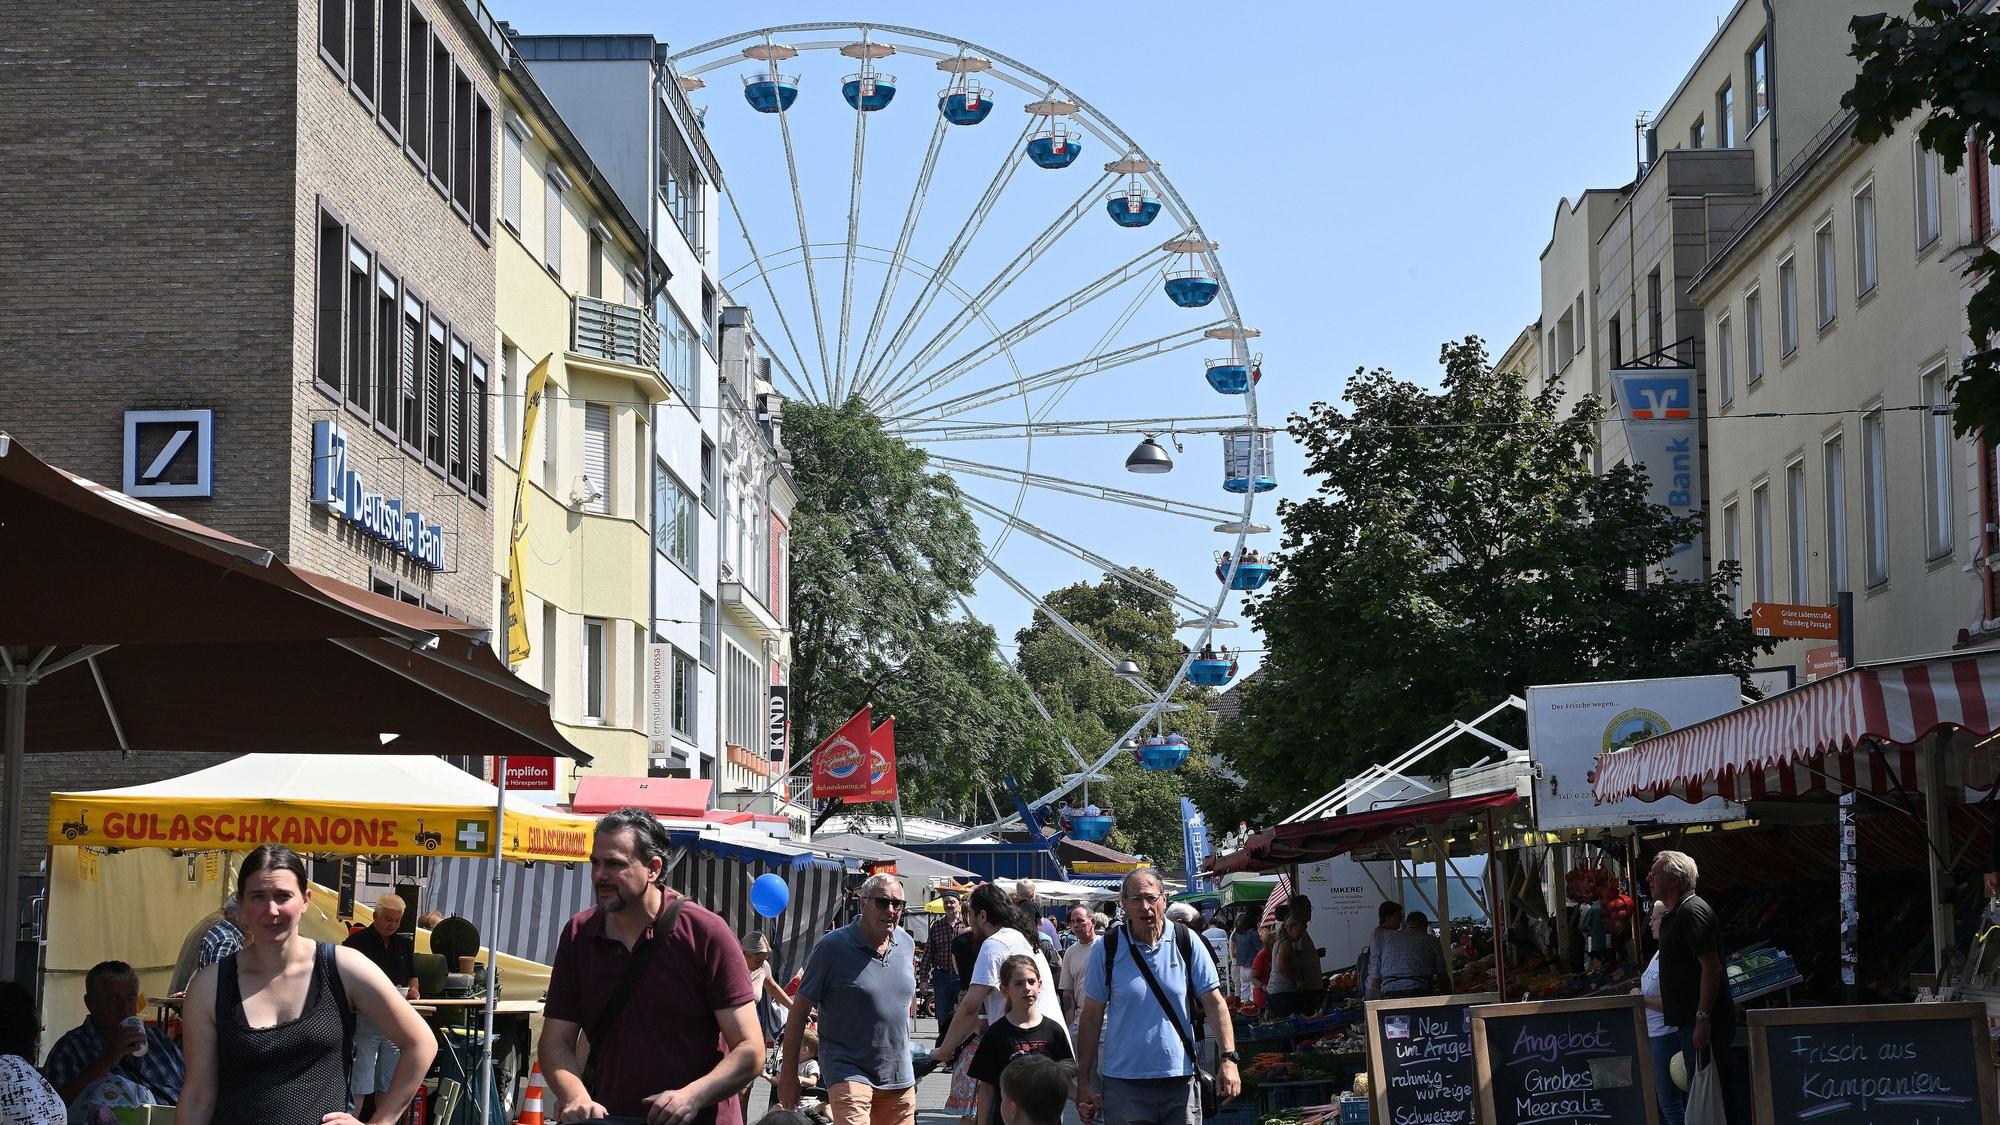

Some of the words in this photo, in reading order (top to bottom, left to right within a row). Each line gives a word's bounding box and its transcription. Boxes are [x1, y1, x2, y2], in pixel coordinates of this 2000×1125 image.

[1664, 436, 1692, 507] Bank
[353, 470, 414, 553] Deutsche
[418, 511, 447, 572] Bank
[1798, 611, 1832, 619] Ladenstraße
[652, 648, 661, 736] lernstudiobarbarossa
[1566, 702, 1590, 710] Frische
[770, 696, 785, 750] KIND
[505, 766, 548, 778] mplifon
[102, 812, 399, 848] GULASCHKANONE
[527, 826, 587, 856] GULASCHKANONE
[1330, 886, 1364, 894] IMKEREI
[1418, 1016, 1449, 1037] Neu
[1396, 1042, 1420, 1059] im
[1512, 1022, 1613, 1062] Angebot
[1789, 1033, 1868, 1064] Frisch
[1879, 1041, 1918, 1061] aus
[1524, 1067, 1593, 1093] Grobes
[1802, 1070, 1952, 1111] Kampanien
[1394, 1105, 1466, 1125] Schweizer
[1516, 1091, 1605, 1117] Meersalz
